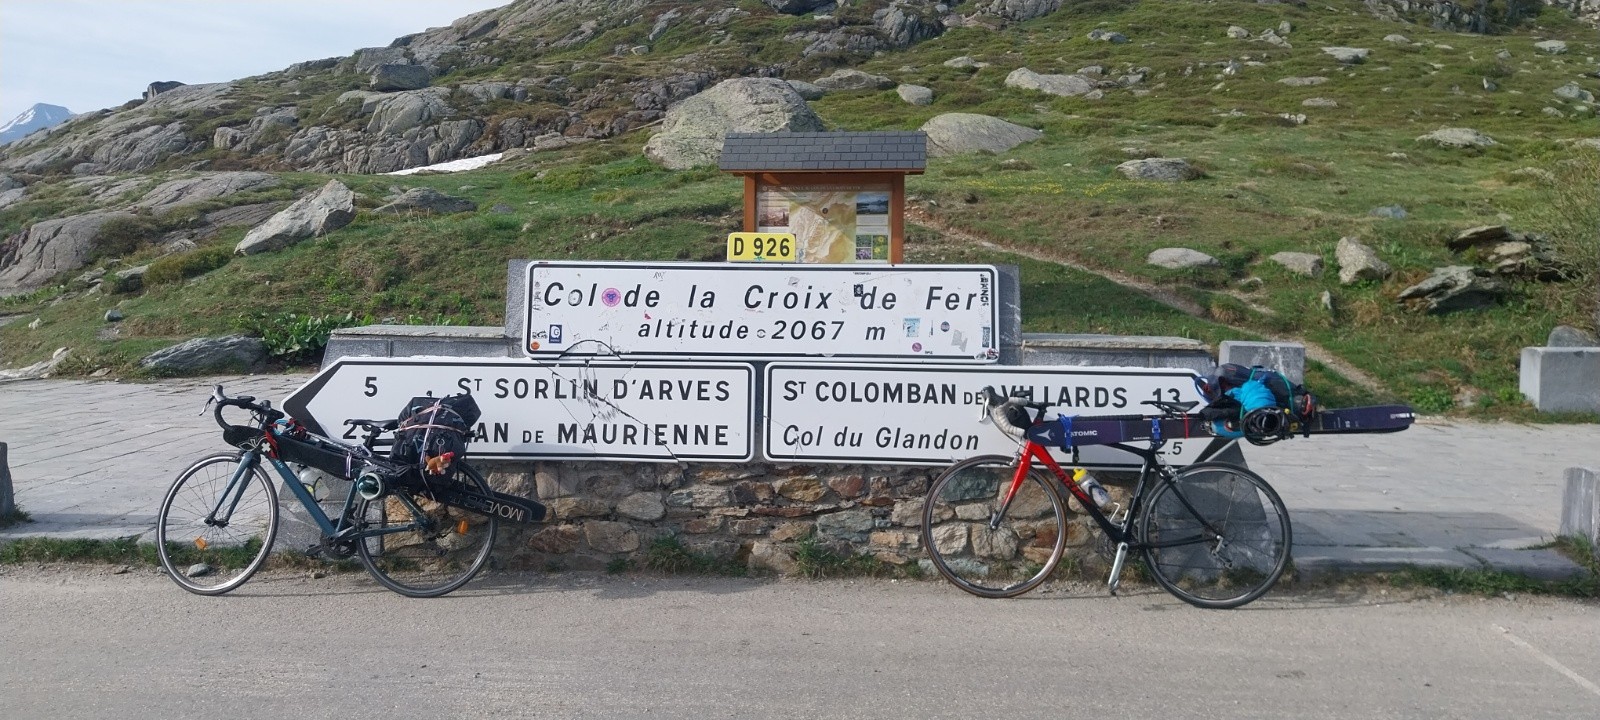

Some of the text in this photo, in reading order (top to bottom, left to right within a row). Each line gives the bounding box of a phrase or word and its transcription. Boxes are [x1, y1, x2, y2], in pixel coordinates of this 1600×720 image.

[733, 237, 790, 257] D 926
[543, 281, 598, 307] Col
[623, 283, 661, 308] de
[688, 284, 716, 309] la
[744, 284, 832, 310] Croix
[859, 285, 897, 311] de
[925, 286, 978, 311] Fer
[637, 319, 886, 341] altitude 2067 m
[364, 376, 378, 398] 5
[493, 378, 599, 400] SORLIN
[613, 379, 731, 402] D'ARVES
[815, 380, 957, 405] COLOMBAN
[963, 391, 984, 405] DE
[1152, 387, 1181, 404] 13
[522, 430, 544, 444] DE
[557, 423, 729, 446] MAURIENNE
[783, 424, 979, 451] Col du Glandon
[1156, 441, 1183, 456] .5
